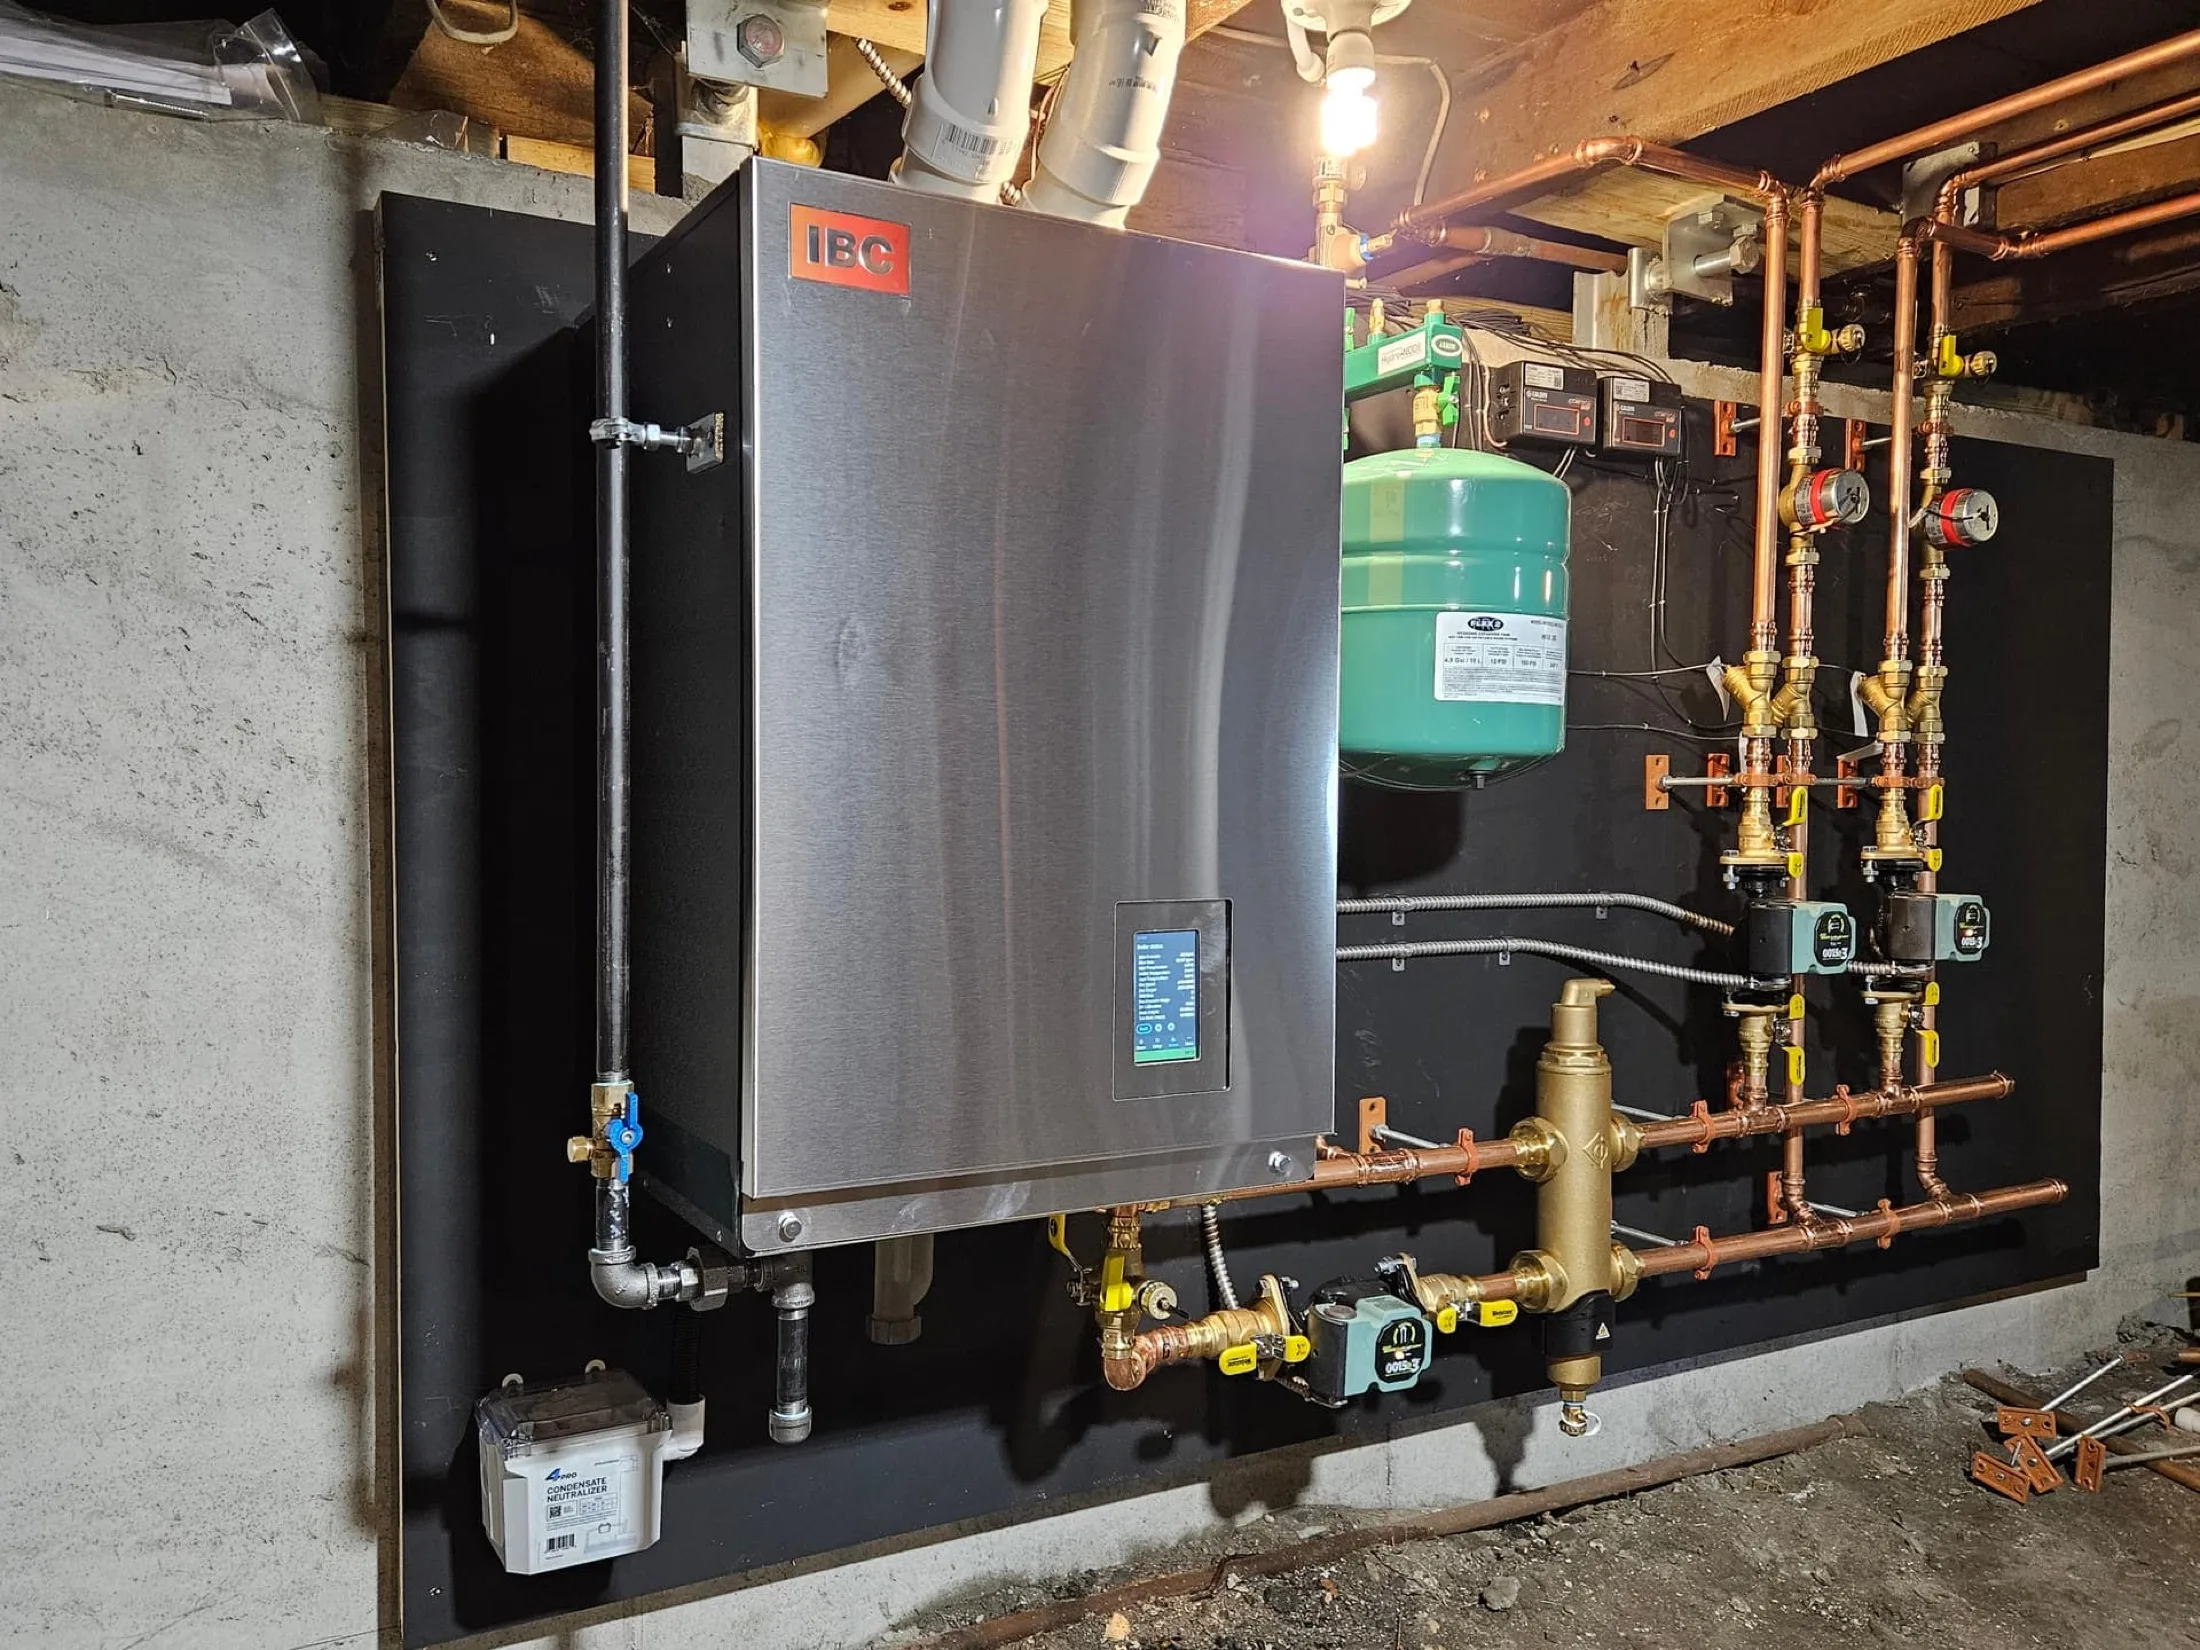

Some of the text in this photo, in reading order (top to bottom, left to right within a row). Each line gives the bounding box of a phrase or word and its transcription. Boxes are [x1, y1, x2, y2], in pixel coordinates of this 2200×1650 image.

[807, 224, 894, 275] IBC
[547, 1477, 607, 1494] CONDENSATE
[547, 1485, 608, 1502] NEUTRALIZER
